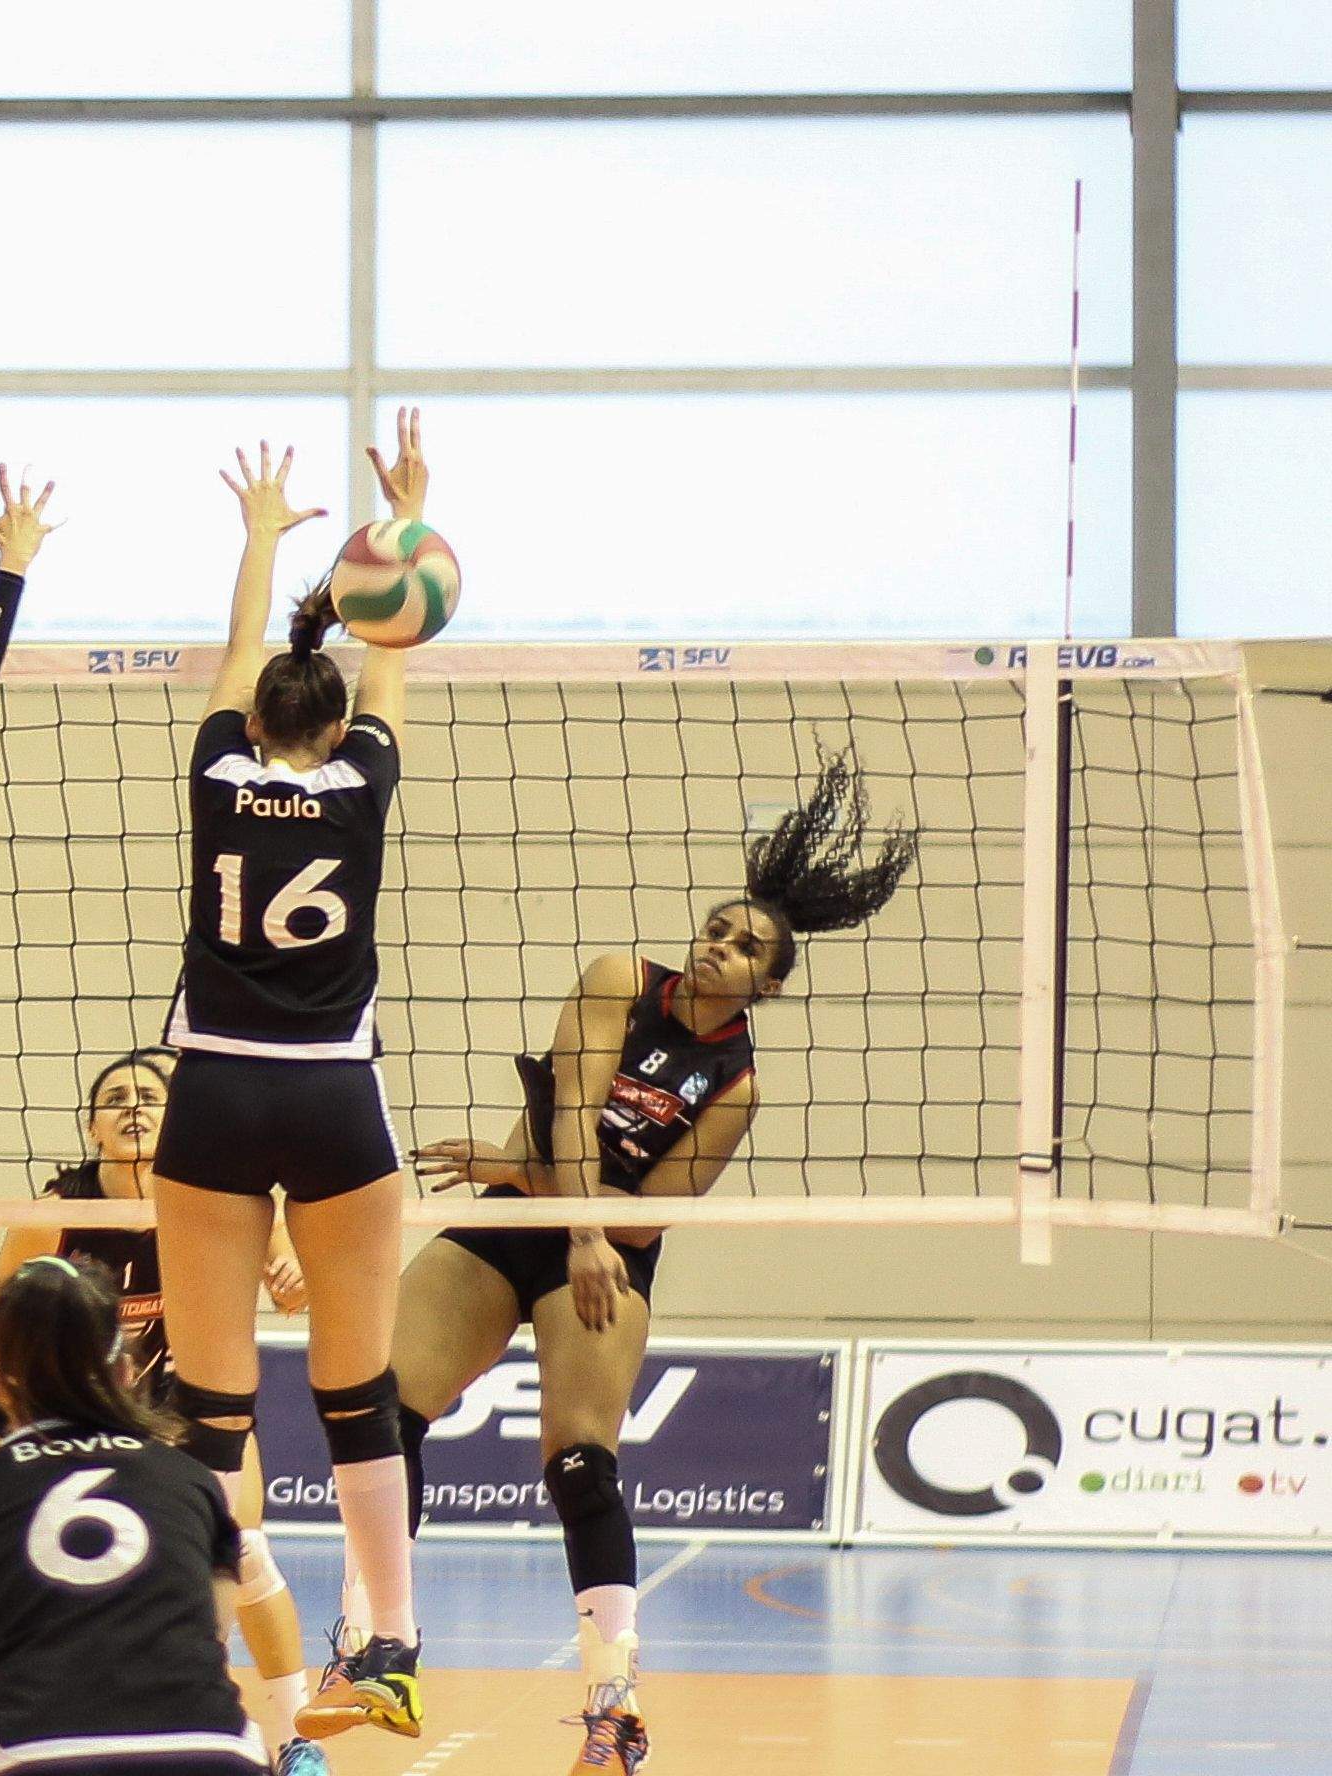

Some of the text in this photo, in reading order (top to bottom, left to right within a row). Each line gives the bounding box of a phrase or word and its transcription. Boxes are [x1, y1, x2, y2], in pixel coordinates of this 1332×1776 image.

[133, 650, 180, 667] SFV
[235, 788, 322, 818] Paula
[213, 854, 348, 949] 16
[638, 1050, 668, 1075] 8
[11, 1433, 144, 1462] Bovio
[267, 1474, 340, 1505] Glob
[423, 1479, 549, 1511] ansport
[634, 1482, 784, 1518] Logistics
[1270, 1471, 1309, 1496] tv
[27, 1467, 150, 1586] 6
